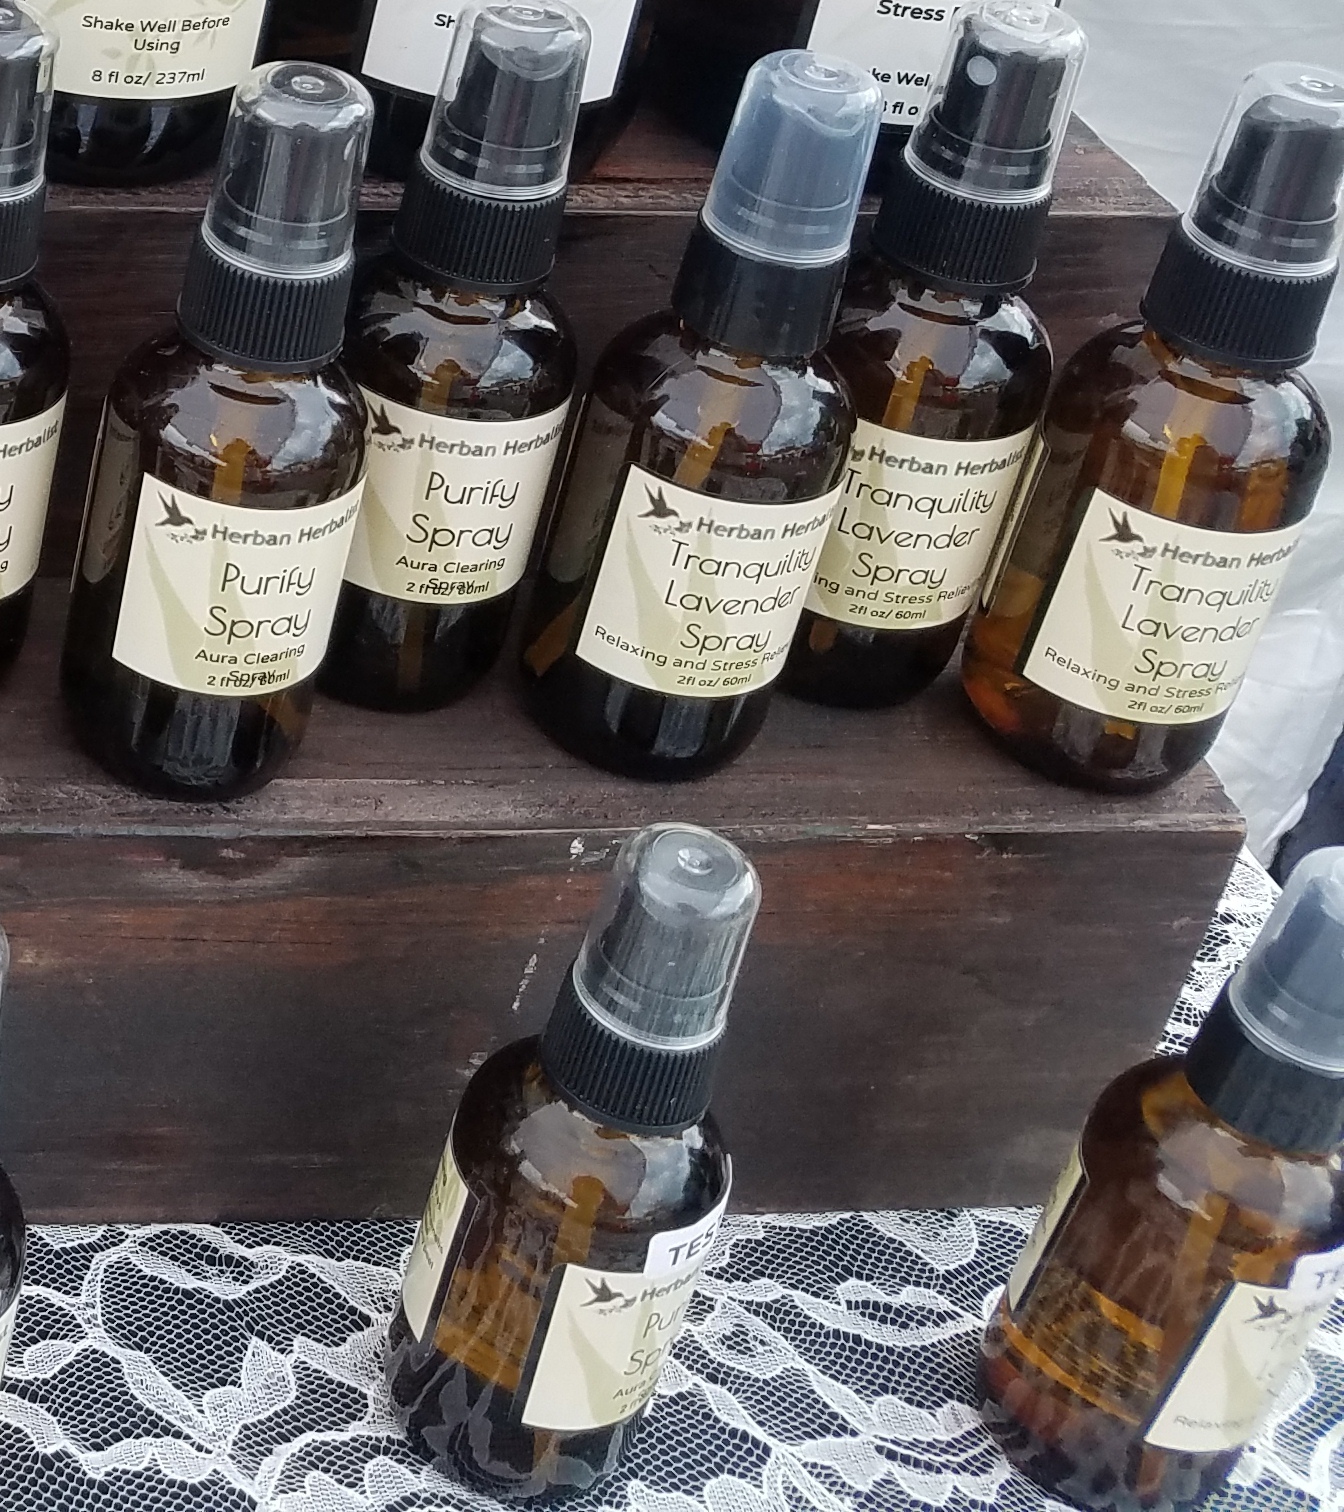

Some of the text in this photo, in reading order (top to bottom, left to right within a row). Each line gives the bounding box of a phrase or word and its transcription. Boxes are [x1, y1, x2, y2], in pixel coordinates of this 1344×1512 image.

[91, 68, 205, 86] 8 fl oz/ 237ml
[425, 471, 520, 509] Purify
[406, 513, 513, 552] Spray
[672, 539, 816, 584] Tranquility
[221, 562, 315, 597] Purify
[665, 580, 800, 615] Lavender
[204, 605, 311, 645] Spray
[680, 624, 771, 656] Spray
[1121, 605, 1260, 643] Lavender
[195, 644, 305, 665] Aura Clearing
[1134, 649, 1227, 682] Spray
